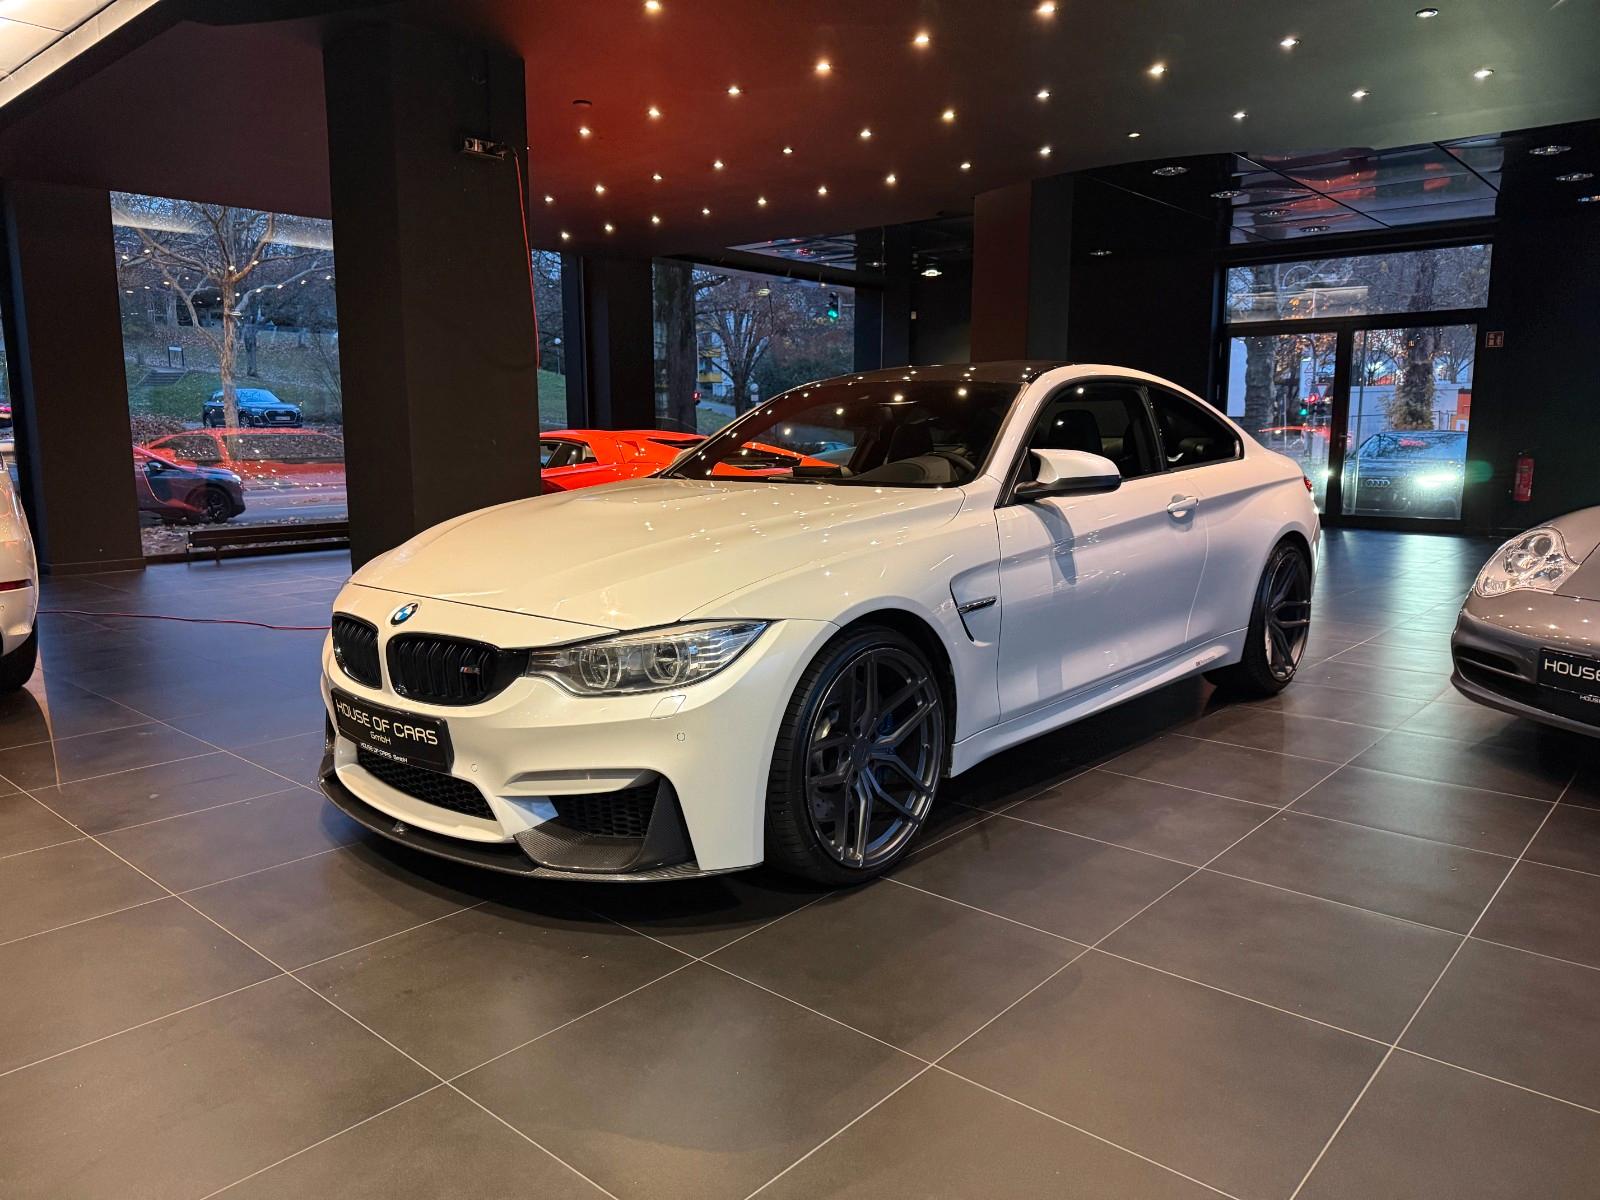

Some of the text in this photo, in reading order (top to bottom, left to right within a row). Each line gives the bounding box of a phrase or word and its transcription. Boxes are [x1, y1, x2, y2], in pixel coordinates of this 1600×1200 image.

[335, 699, 438, 745] HOUSE OF CARS
[369, 731, 391, 745] GmbH
